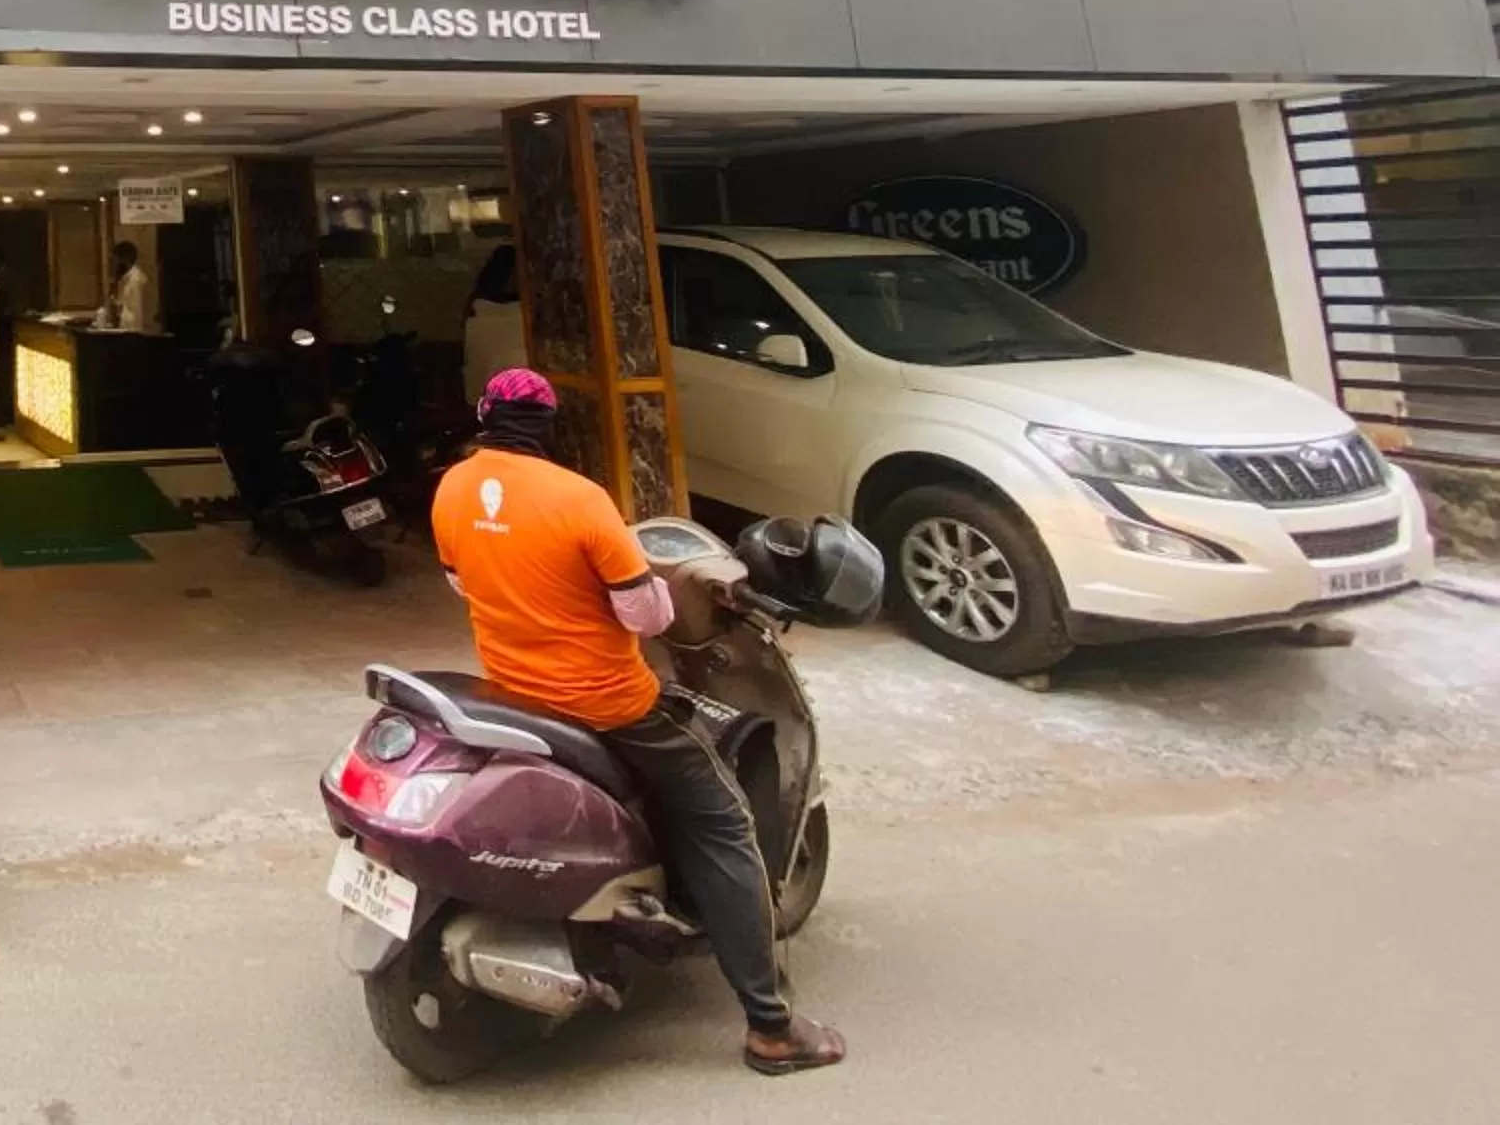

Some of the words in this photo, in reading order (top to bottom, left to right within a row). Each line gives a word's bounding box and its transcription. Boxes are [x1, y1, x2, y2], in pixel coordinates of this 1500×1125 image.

[168, 2, 352, 34] BUSINESS
[362, 6, 479, 37] CLASS
[488, 9, 601, 39] HOTEL
[468, 850, 565, 873] Jupiter
